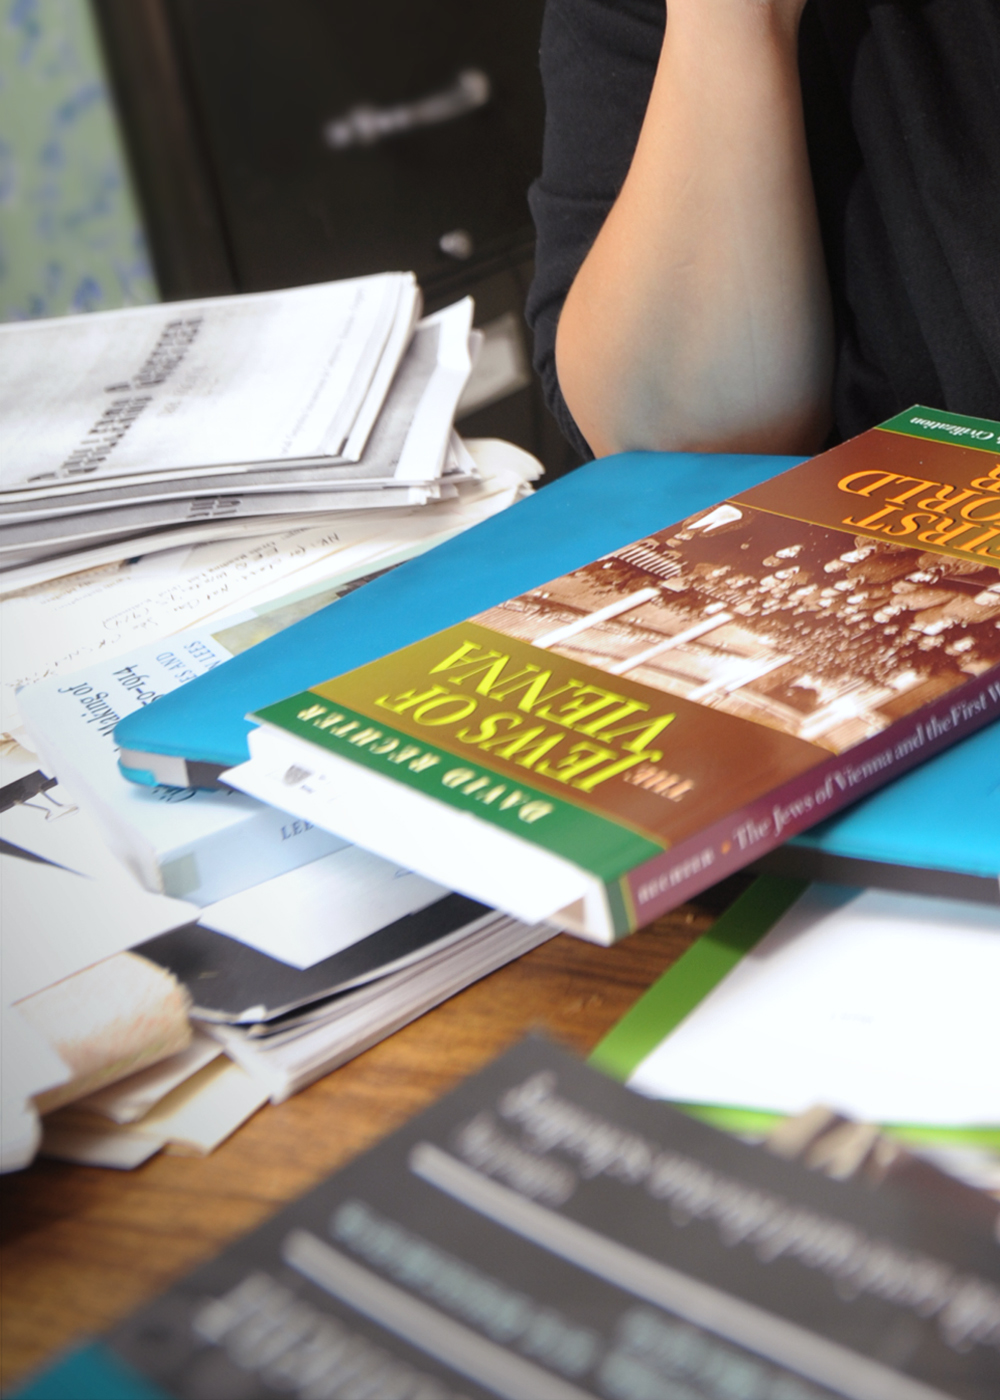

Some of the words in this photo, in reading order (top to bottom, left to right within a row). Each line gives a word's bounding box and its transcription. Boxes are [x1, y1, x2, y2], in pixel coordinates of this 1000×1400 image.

[909, 416, 995, 441] Civilization
[156, 652, 185, 677] AND
[184, 640, 216, 662] LEES
[57, 682, 94, 697] of
[374, 684, 478, 727] OF
[428, 640, 676, 753] VIENNA
[296, 705, 441, 773] RECHTER
[455, 712, 663, 793] JEWS
[623, 764, 695, 802] THE
[732, 815, 771, 852] The
[770, 795, 815, 837] Jews
[812, 777, 835, 806] of
[832, 751, 894, 790] Vienna
[890, 723, 925, 760] and
[922, 712, 952, 745] the
[947, 695, 987, 730] First
[441, 767, 554, 824] DAVID
